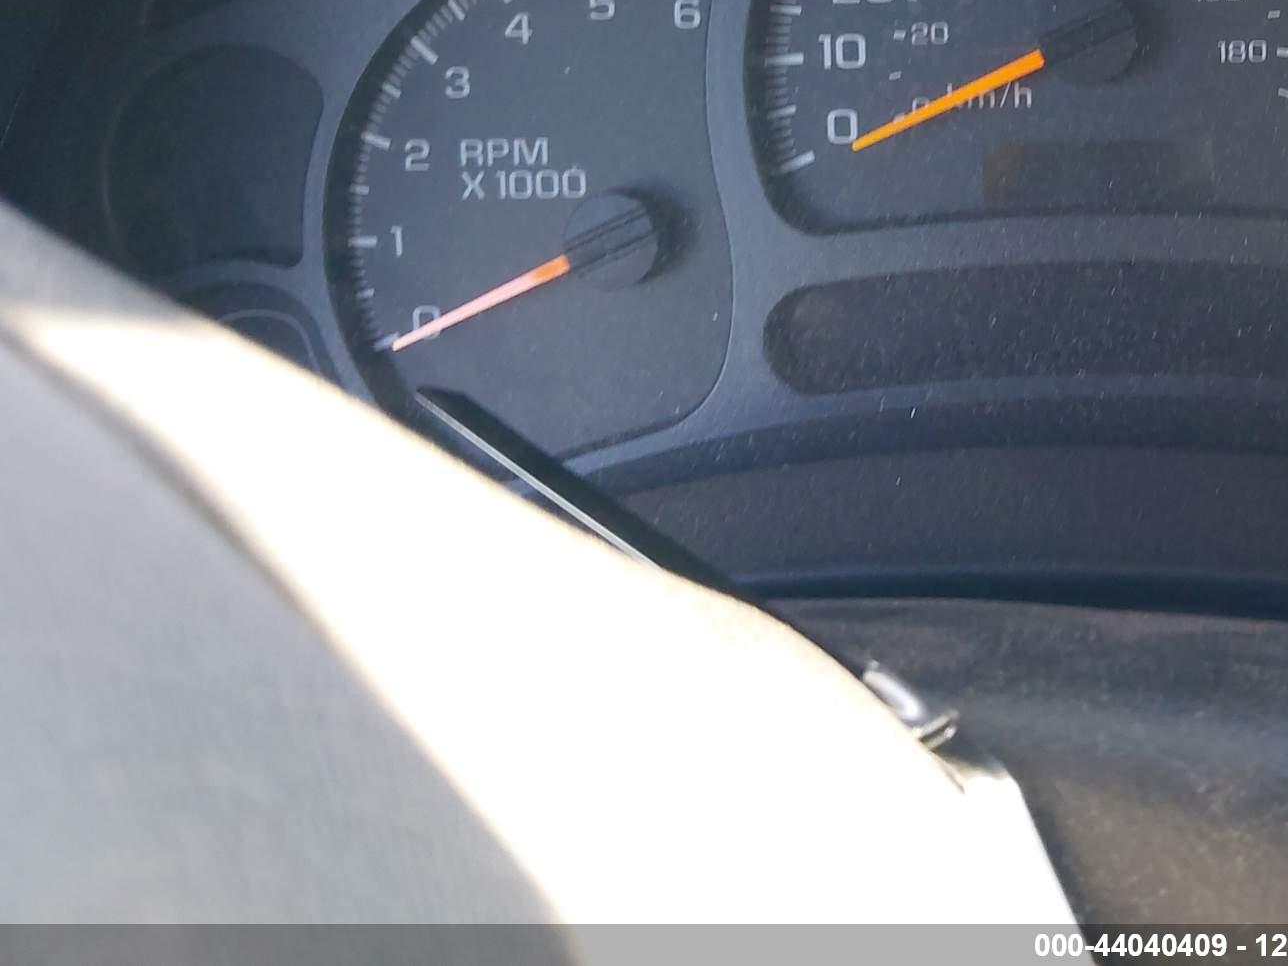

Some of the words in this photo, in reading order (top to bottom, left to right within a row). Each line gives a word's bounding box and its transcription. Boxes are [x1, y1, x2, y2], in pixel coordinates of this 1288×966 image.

[504, 13, 532, 44] 4
[911, 22, 948, 44] 20
[818, 34, 866, 69] 10
[1218, 40, 1267, 63] 180
[444, 66, 471, 98] 3
[946, 83, 1032, 109] m/h
[827, 109, 859, 145] 0
[404, 140, 430, 171] 2
[460, 138, 549, 167] RPM
[461, 171, 485, 200] X
[496, 170, 587, 199] 1000
[390, 226, 402, 255] 1
